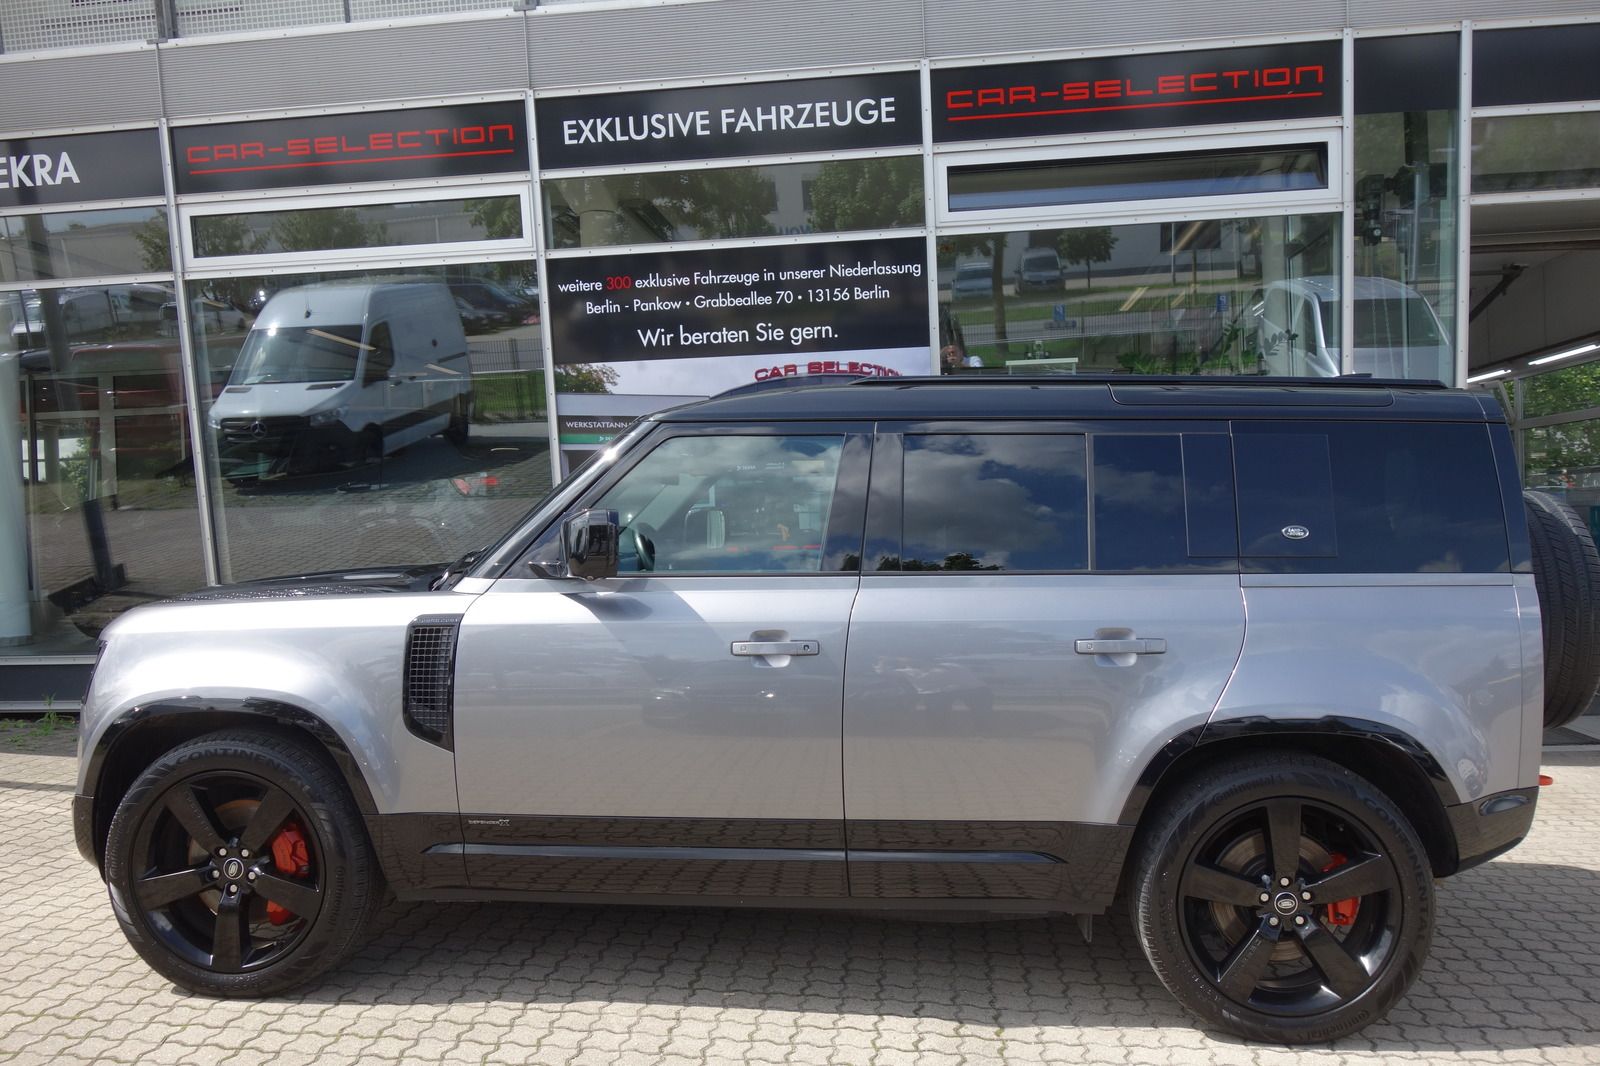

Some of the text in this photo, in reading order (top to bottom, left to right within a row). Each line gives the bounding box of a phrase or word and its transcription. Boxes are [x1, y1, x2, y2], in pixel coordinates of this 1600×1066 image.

[946, 65, 1324, 109] CAR-SELECTION
[564, 98, 896, 144] EXKLUSIVE FAHRZEUGE
[186, 124, 514, 164] CAR-SELECTION
[0, 151, 81, 188] EKRA
[558, 260, 922, 293] weitere 300 exklusive Fahrzeuge in unserer Niederlassung
[586, 299, 621, 315] Berlin
[633, 296, 682, 312] Pankow
[694, 290, 773, 309] Grabbeallee
[776, 290, 794, 305] 70
[807, 287, 850, 303] 13156
[854, 285, 890, 301] Berlin
[637, 322, 839, 348] Wir beraten Sie gern.
[754, 361, 903, 382] CAR SELECTIO
[565, 421, 632, 429] WERKSTATTANN
